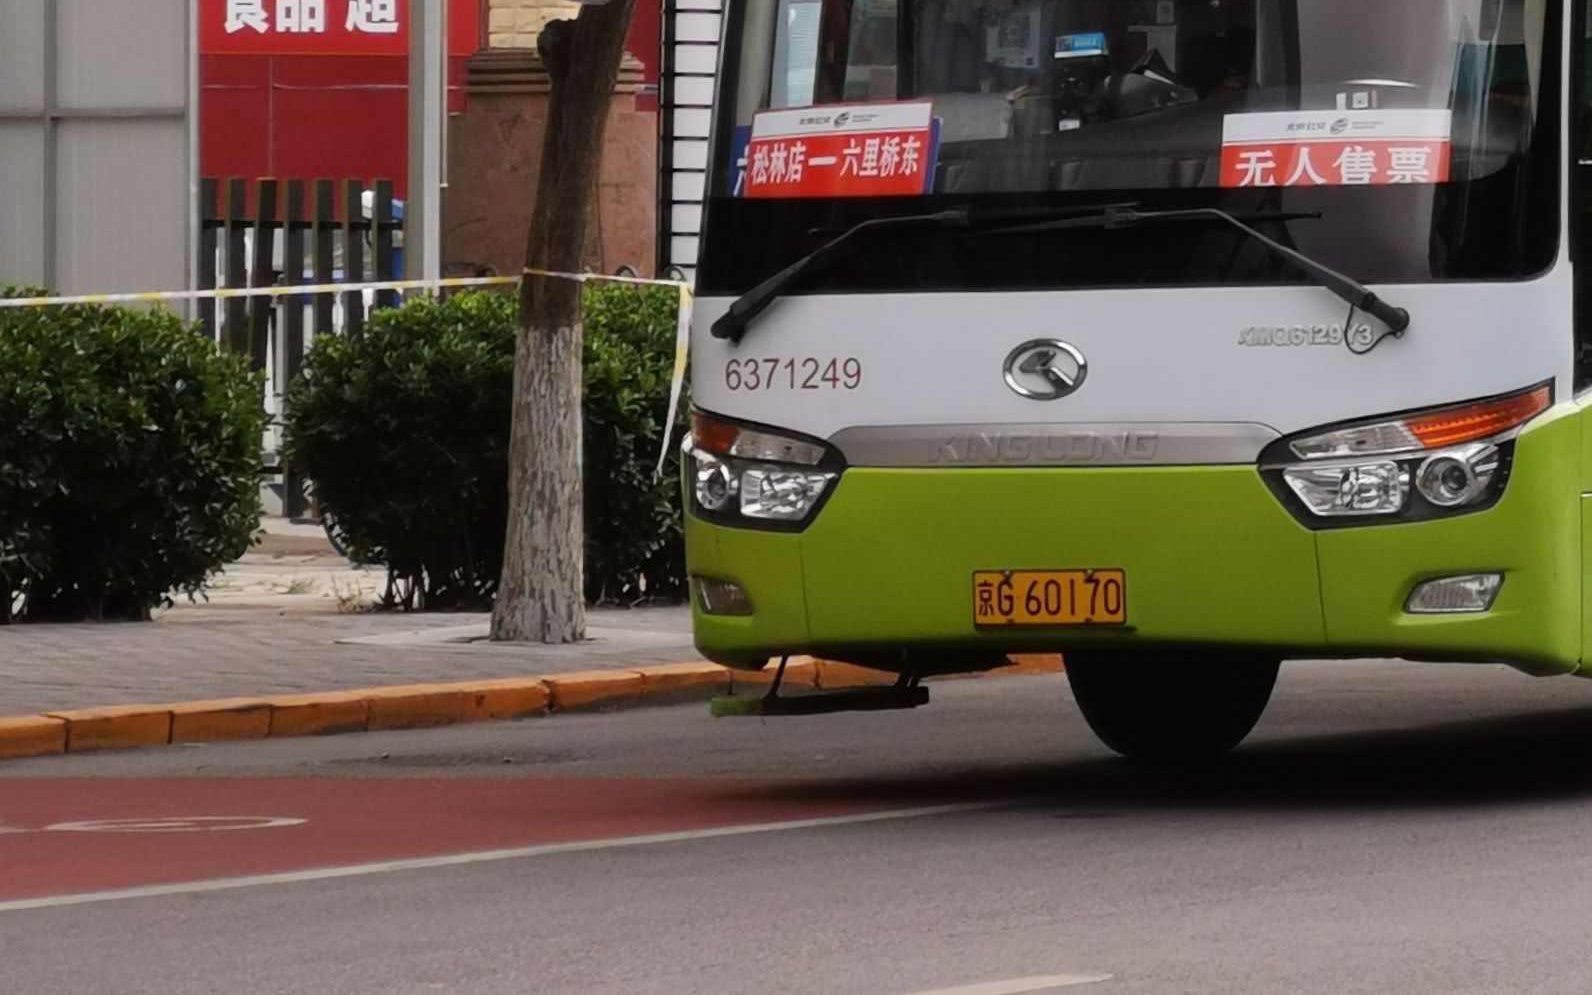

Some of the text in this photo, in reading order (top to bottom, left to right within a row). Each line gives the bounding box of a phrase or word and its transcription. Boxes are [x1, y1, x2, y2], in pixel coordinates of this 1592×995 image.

[1234, 146, 1432, 187] 无人售票
[724, 357, 862, 392] 6371249
